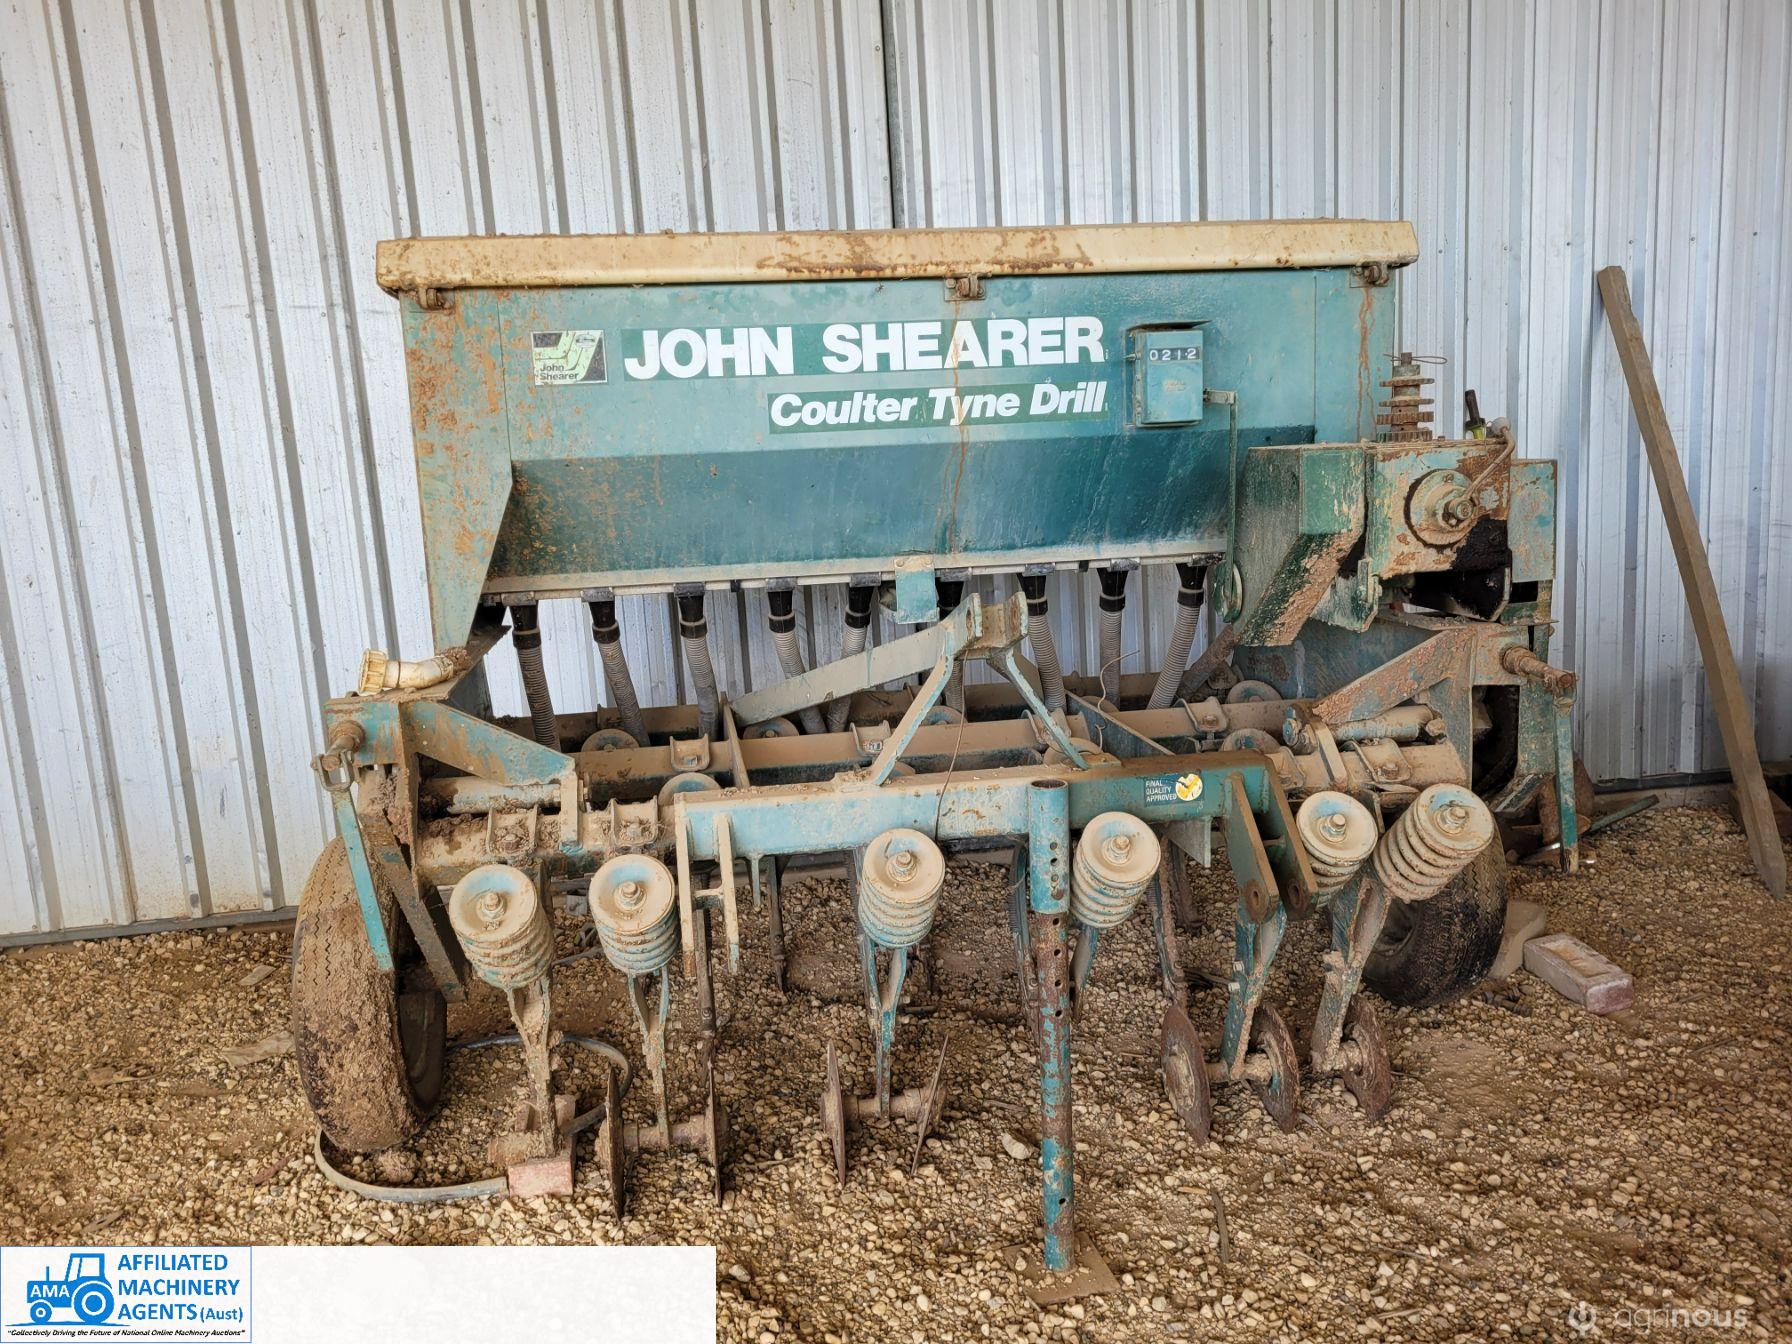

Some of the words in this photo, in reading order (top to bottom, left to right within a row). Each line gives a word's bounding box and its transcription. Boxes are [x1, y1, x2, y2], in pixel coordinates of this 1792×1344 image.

[624, 326, 794, 380] JOHN
[821, 316, 1105, 374] SHEARER
[540, 364, 565, 372] John
[540, 372, 579, 380] Shearer
[771, 391, 918, 427] Coulter
[928, 387, 1021, 426] Tyne
[1029, 381, 1108, 415] Drill
[1146, 786, 1171, 795] QUALITY
[1146, 794, 1177, 802] APPROVED
